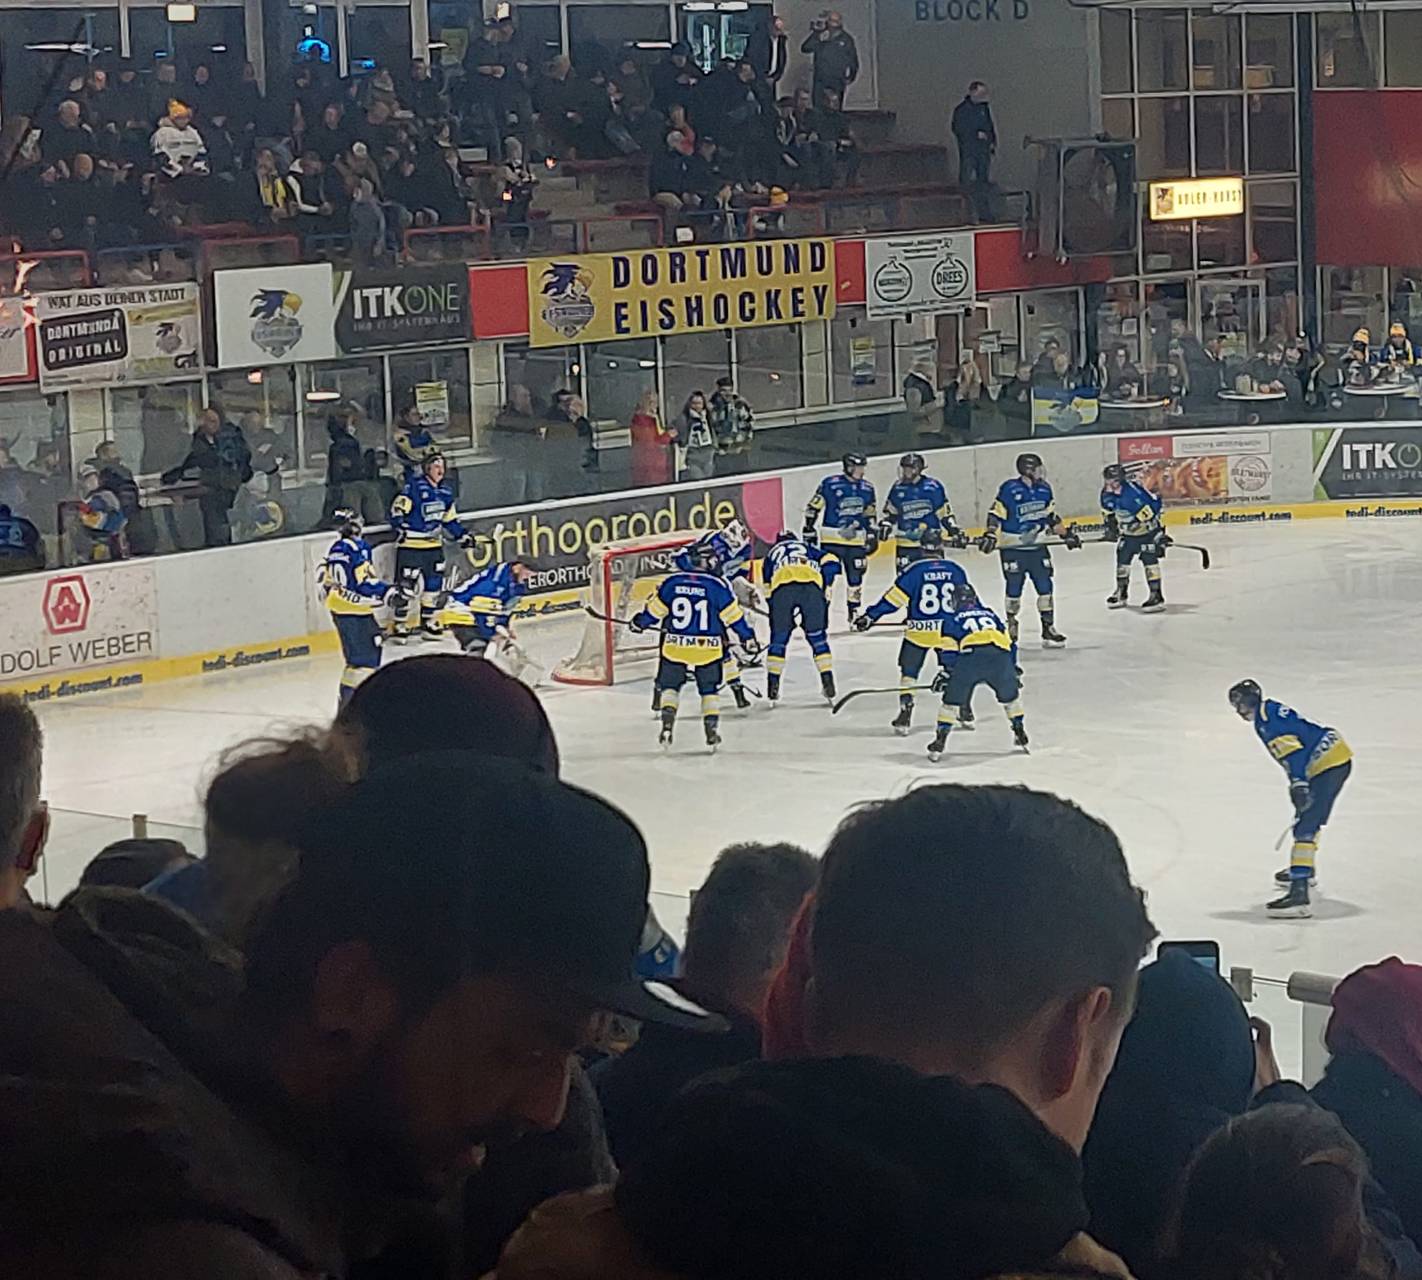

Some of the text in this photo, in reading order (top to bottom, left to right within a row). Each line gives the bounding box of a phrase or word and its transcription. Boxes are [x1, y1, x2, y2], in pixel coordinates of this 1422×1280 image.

[915, 0, 1029, 20] BLOCK D
[612, 242, 826, 289] DORTMUND
[77, 294, 102, 307] AUS
[150, 288, 186, 303] STADT
[614, 284, 828, 335] EISHOCKEY
[923, 571, 953, 581] KRAFT
[671, 597, 709, 631] 91
[919, 582, 956, 615] 88
[69, 632, 152, 663] WEBER
